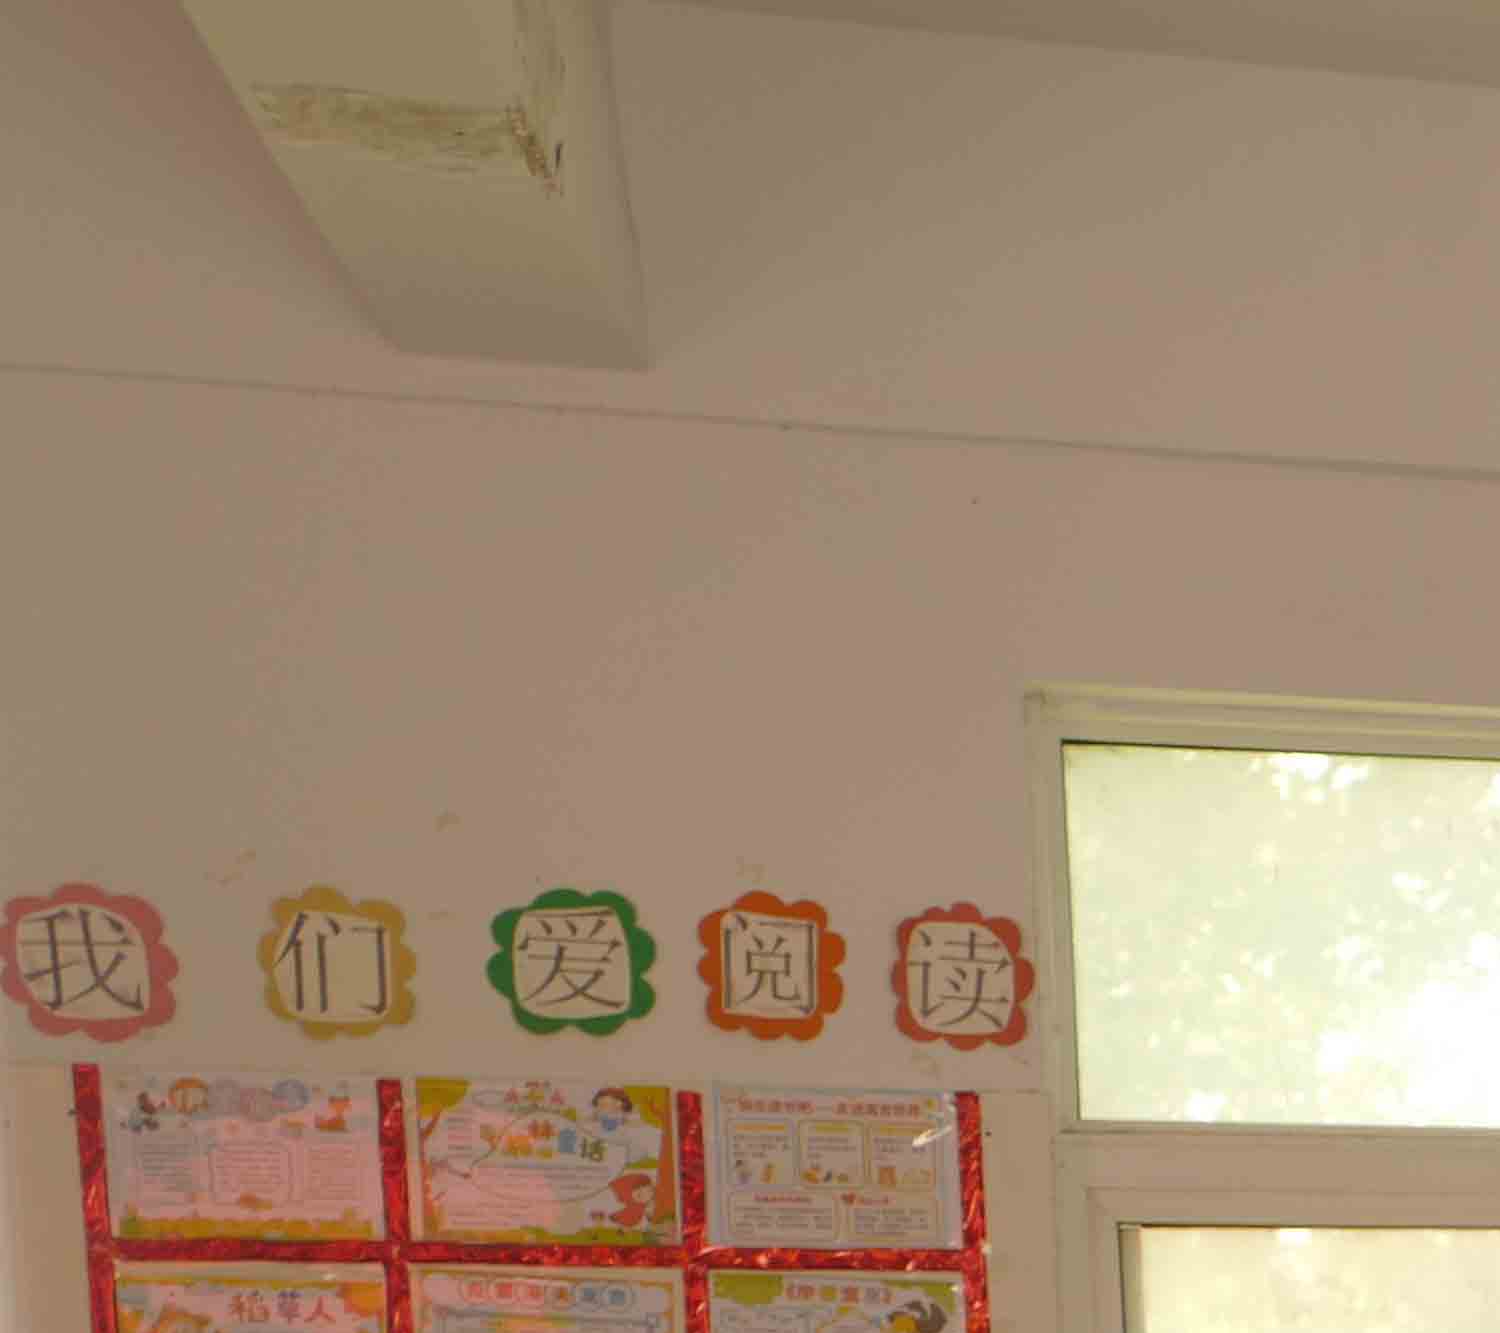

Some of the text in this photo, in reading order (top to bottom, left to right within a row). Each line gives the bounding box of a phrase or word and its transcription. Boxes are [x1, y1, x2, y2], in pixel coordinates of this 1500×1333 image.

[24, 906, 1014, 1030] 我们爱阅读
[227, 1290, 336, 1325] 稻草人
